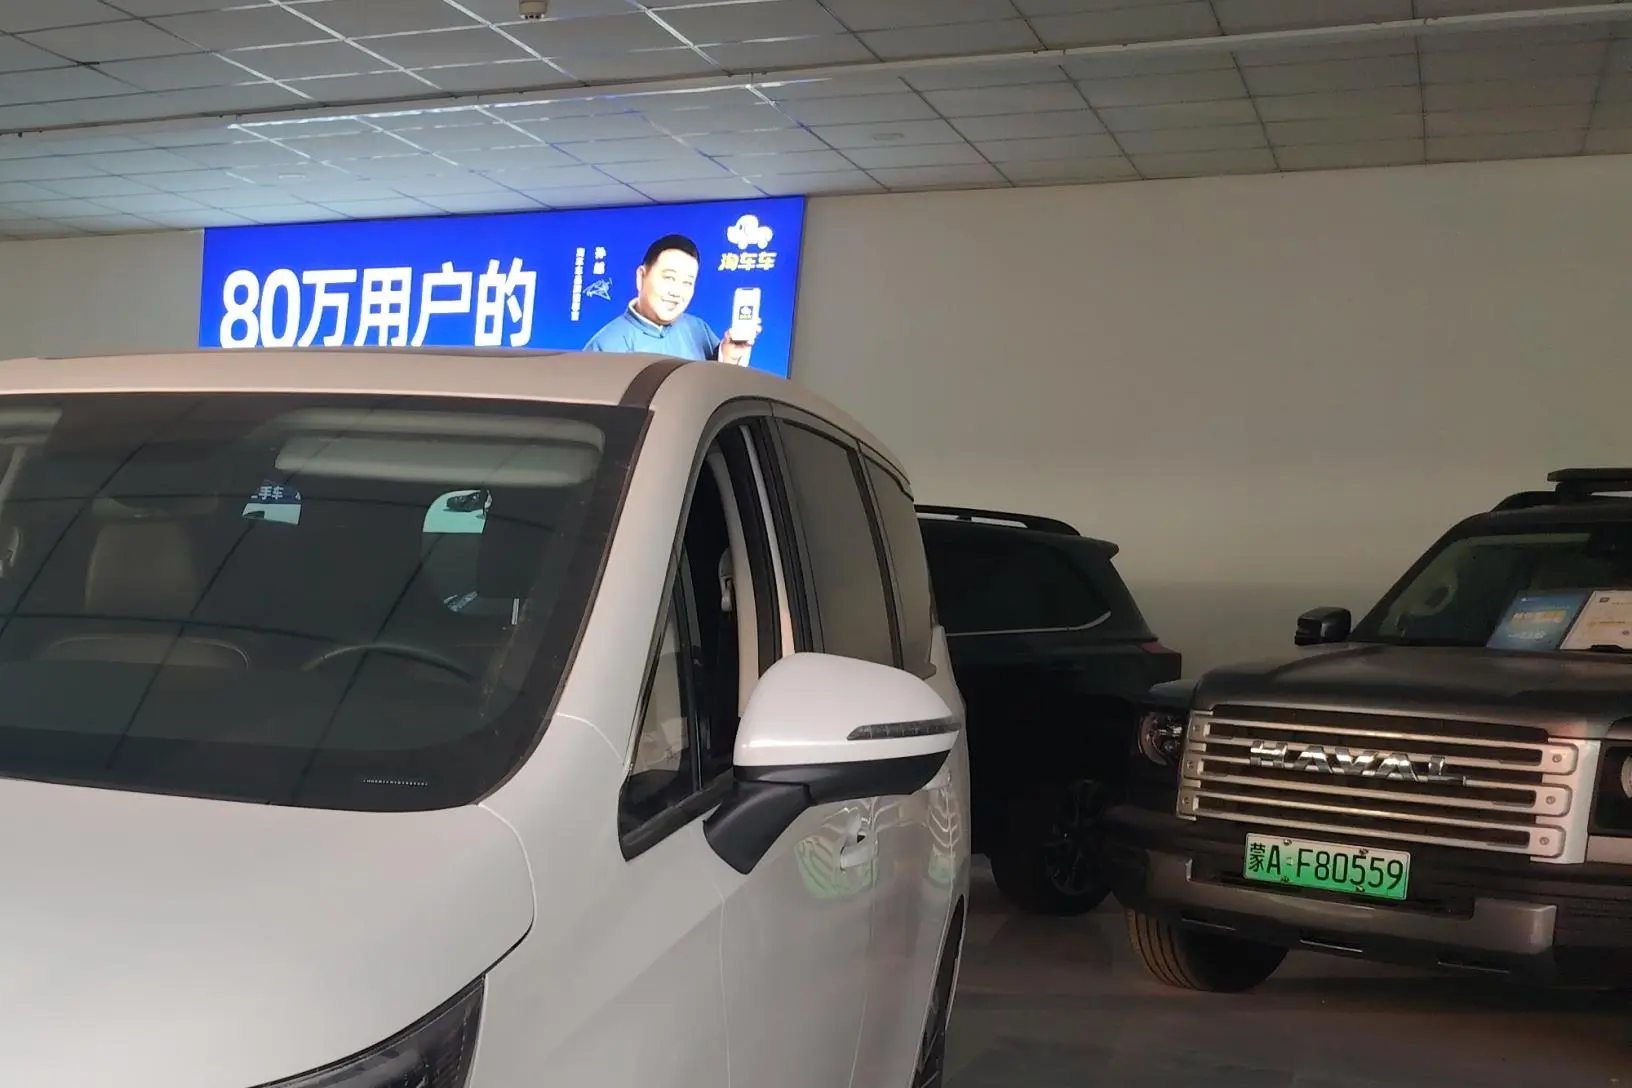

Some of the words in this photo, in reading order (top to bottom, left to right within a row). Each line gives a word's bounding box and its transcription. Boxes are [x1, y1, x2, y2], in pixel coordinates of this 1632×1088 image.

[221, 258, 537, 348] 80万用户的
[1250, 740, 1467, 787] HAVAL
